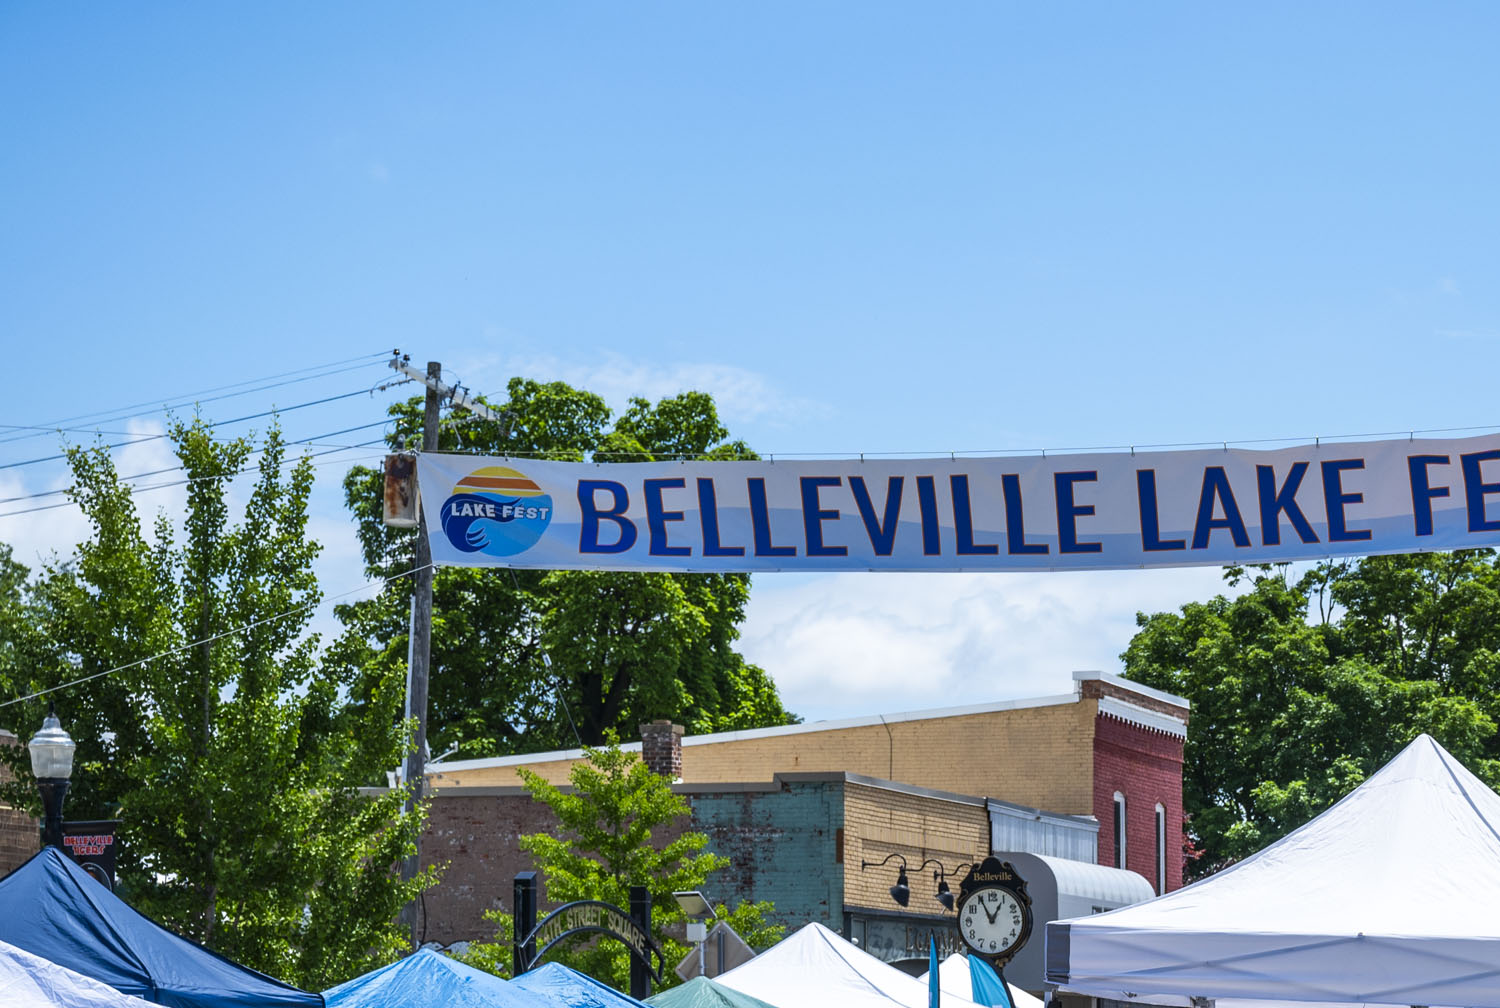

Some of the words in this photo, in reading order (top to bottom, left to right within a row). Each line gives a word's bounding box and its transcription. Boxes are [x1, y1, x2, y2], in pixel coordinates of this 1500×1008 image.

[451, 503, 496, 518] LAKE
[502, 504, 549, 520] FEST
[577, 470, 1103, 557] BELLEVILLE
[1136, 458, 1373, 553] LAKE
[63, 835, 114, 846] BELLEVILLE
[72, 845, 106, 855] TIGERS
[973, 872, 1013, 881] Belleville
[566, 906, 602, 930] STREET
[608, 911, 646, 955] SQUARE
